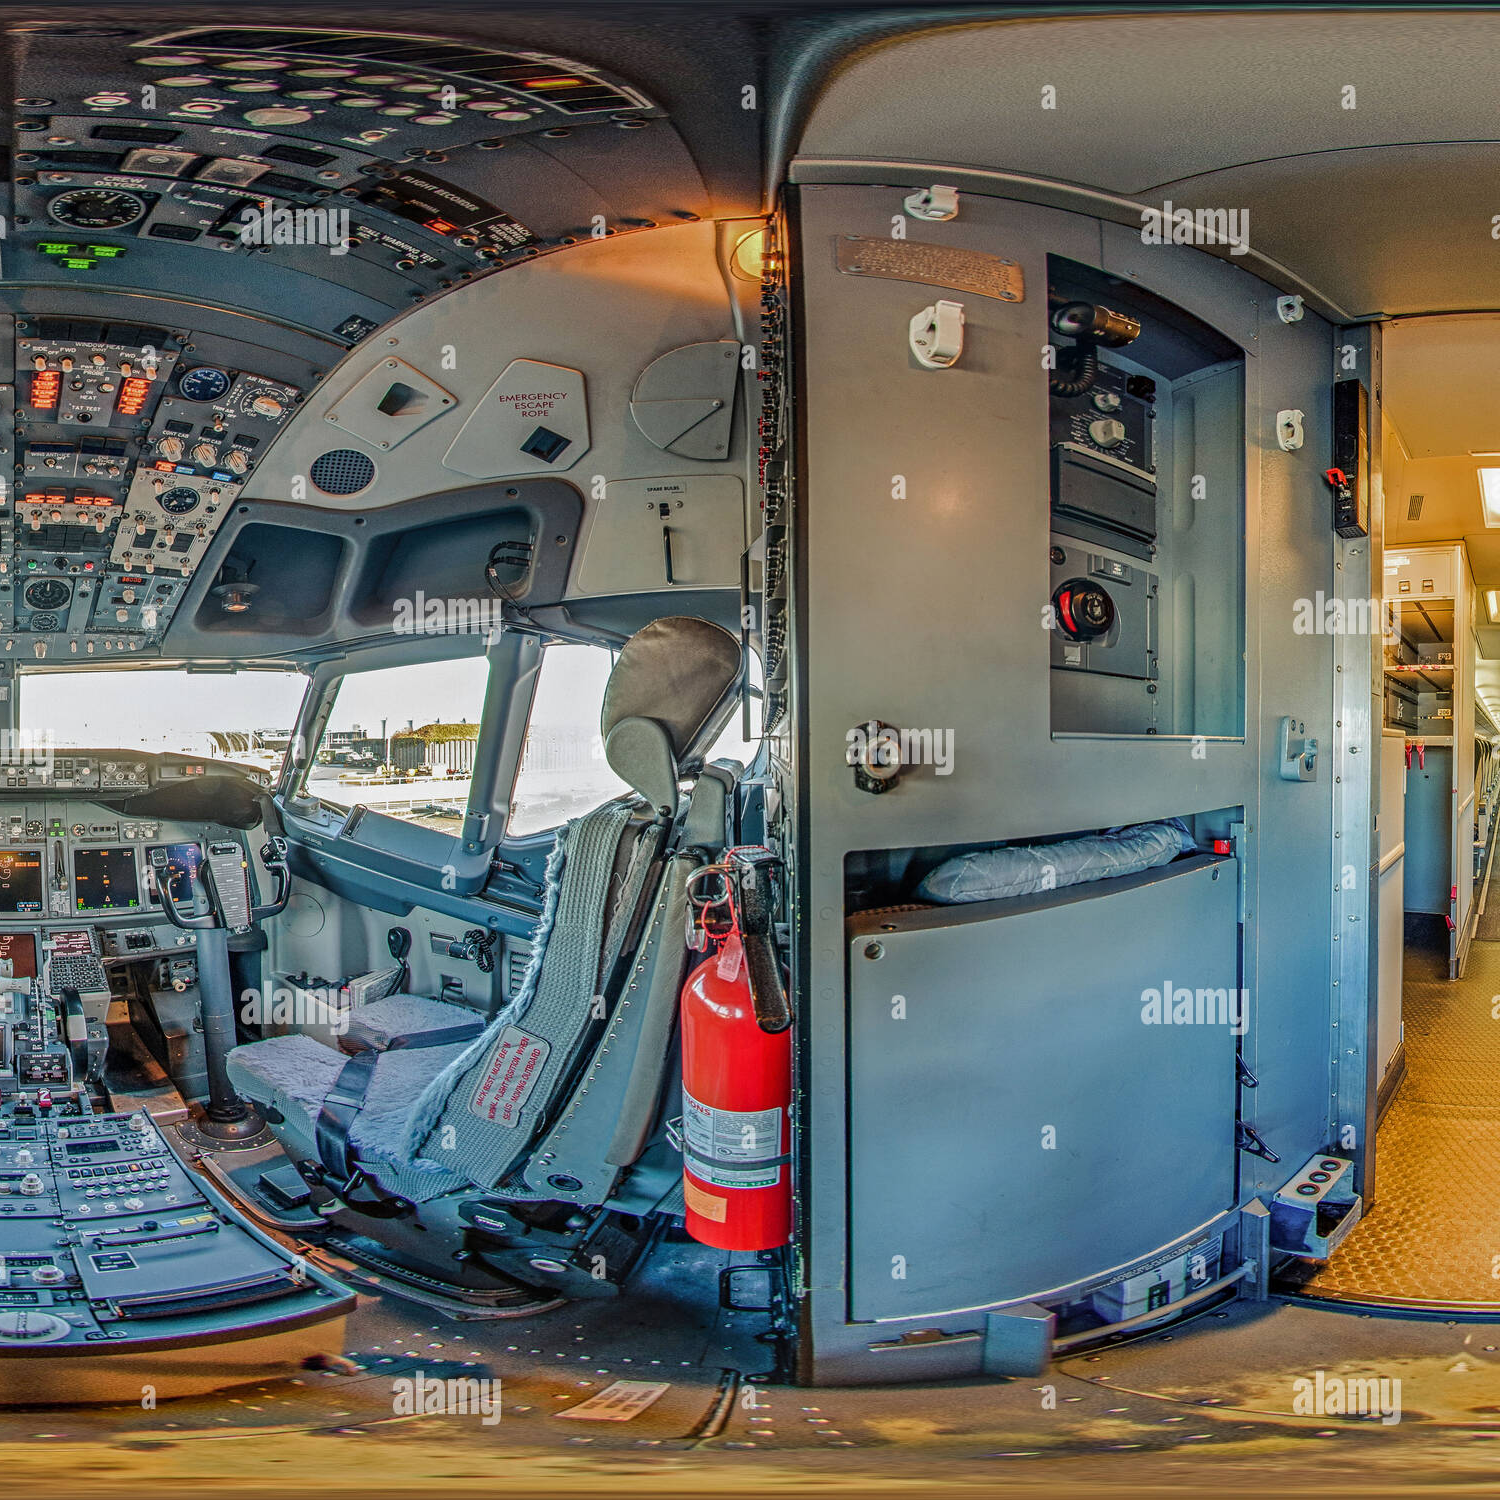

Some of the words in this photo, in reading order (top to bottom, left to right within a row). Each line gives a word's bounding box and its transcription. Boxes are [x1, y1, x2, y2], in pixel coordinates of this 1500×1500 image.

[400, 175, 435, 192] FLIGHT
[382, 235, 421, 255] WARNING
[420, 252, 439, 263] TEST
[499, 391, 569, 403] EMERGENCY
[513, 400, 555, 410] ESCAPE
[521, 409, 549, 419] ROPE
[493, 1080, 510, 1102] FLIGHT
[502, 1055, 523, 1083] POSITION
[514, 1035, 531, 1057] WHEN
[509, 1078, 528, 1103] MOVING
[519, 1047, 543, 1081] OUTBOARD
[474, 1089, 489, 1107] BACK
[489, 1058, 504, 1076] MUST
[40, 1090, 51, 1102] 2
